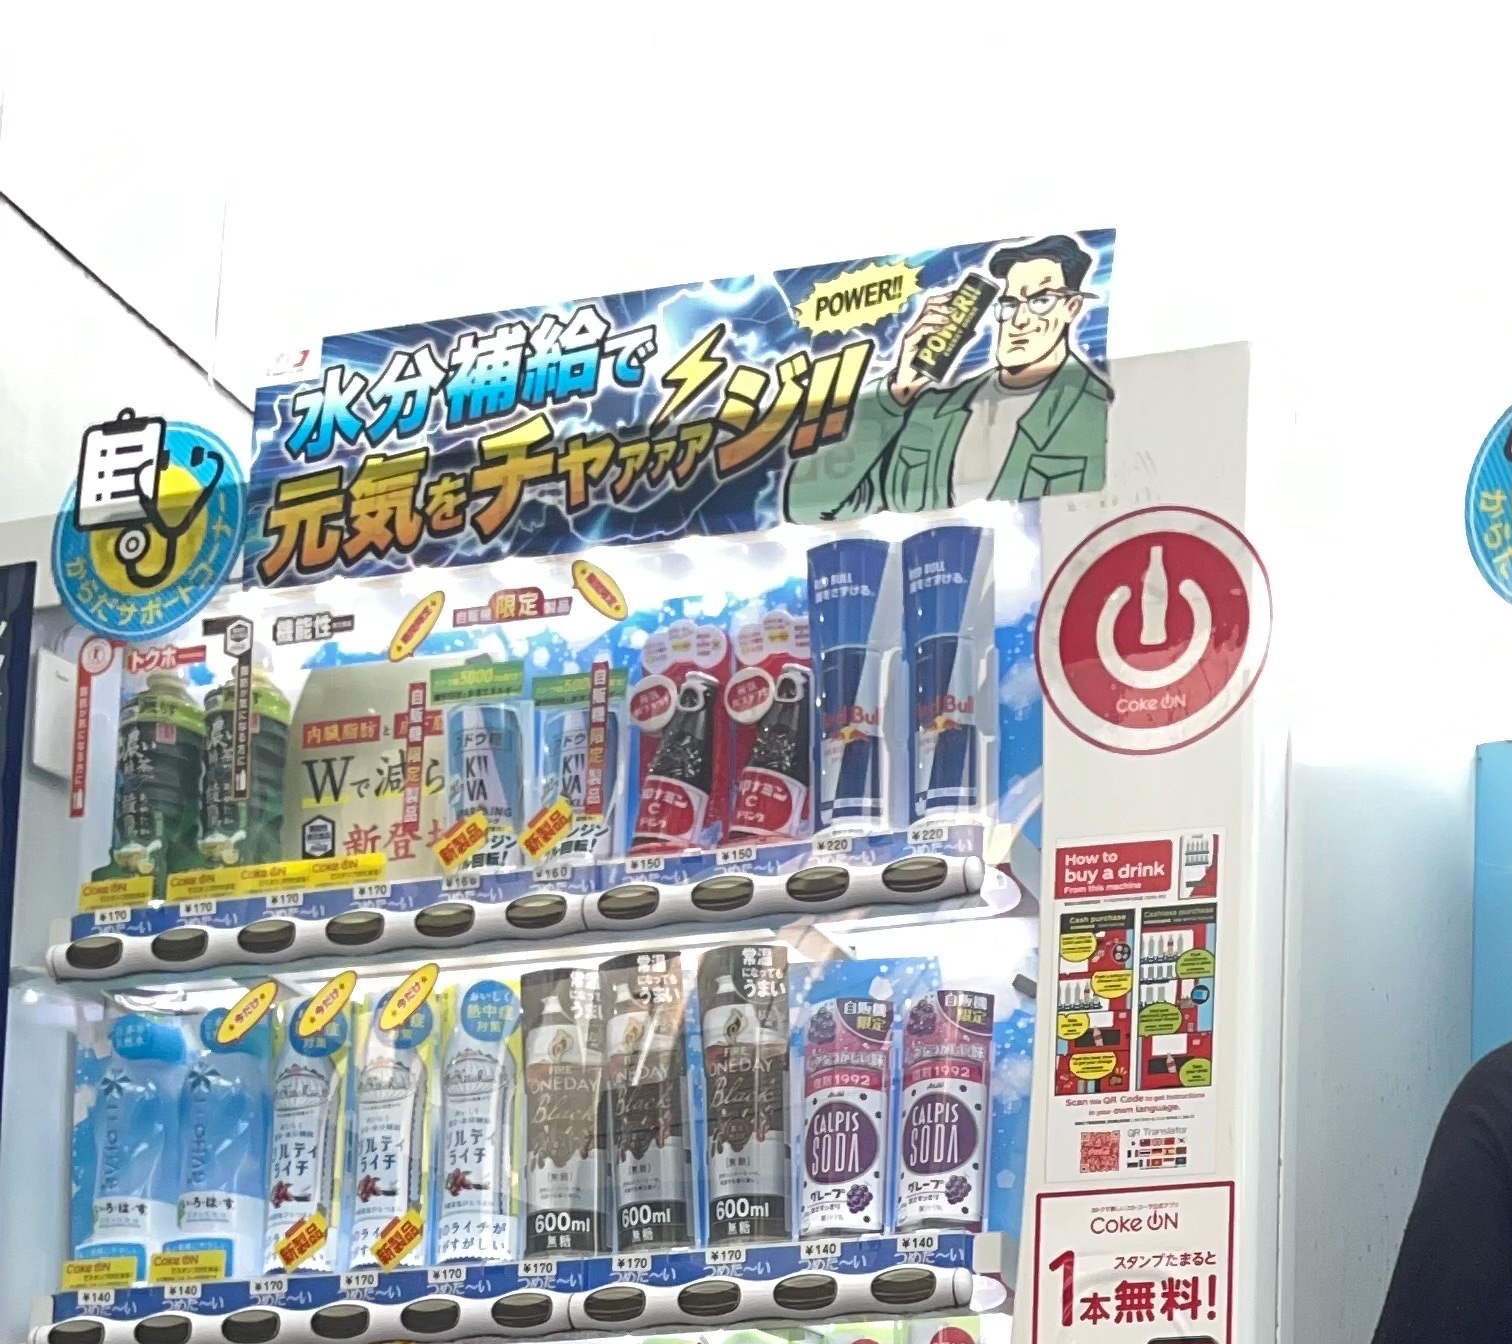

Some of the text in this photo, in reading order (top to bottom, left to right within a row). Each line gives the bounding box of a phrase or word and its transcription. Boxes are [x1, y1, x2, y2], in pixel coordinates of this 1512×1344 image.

[814, 274, 903, 321] POWER!!
[919, 282, 978, 368] POWER!!
[287, 304, 657, 461] 水分補給で
[129, 646, 177, 673] トクホ
[1116, 694, 1158, 713] Coke
[912, 828, 943, 840] ¥220
[817, 838, 848, 851] ¥220
[1065, 852, 1118, 867] How to
[1064, 861, 1165, 885] buy a drink
[271, 893, 299, 904] ¥170
[358, 885, 387, 896] ¥170
[99, 909, 127, 921] ¥170
[814, 1110, 859, 1135] CALPIS
[912, 1103, 959, 1126] CALPIS
[812, 1133, 859, 1176] SODA
[910, 1124, 958, 1167] SODA
[810, 1188, 845, 1201] グレープ
[908, 1179, 944, 1192] グレープ
[622, 1205, 671, 1227] 600ml
[716, 1198, 769, 1218] 600ml
[535, 1212, 590, 1233] 600ml
[1090, 1210, 1178, 1235] Coke ON
[805, 1243, 837, 1255] ¥140
[902, 1237, 933, 1248] ¥140
[1114, 1251, 1217, 1270] スタンプたまると
[1049, 1249, 1217, 1327] 1本無料!
